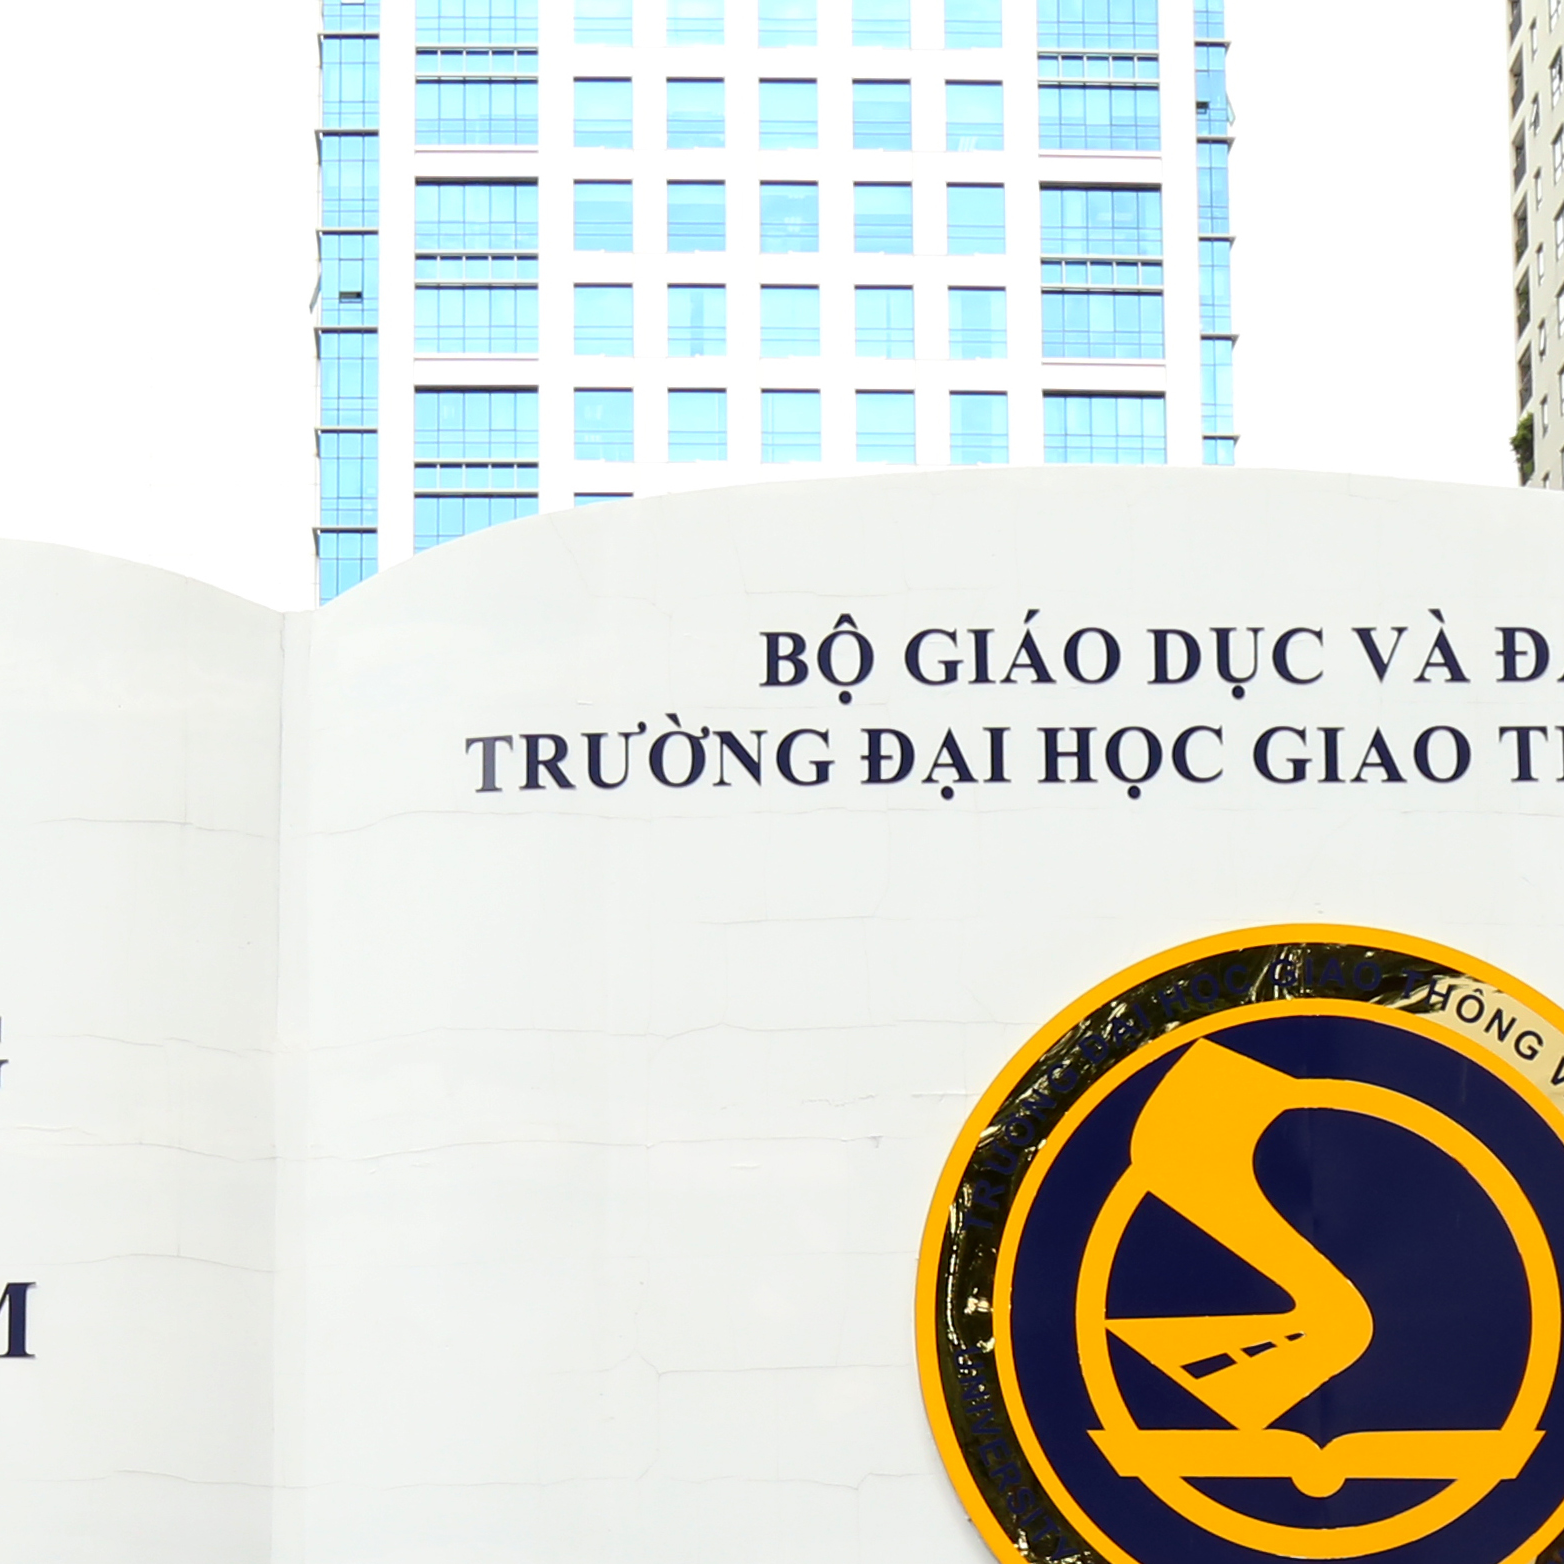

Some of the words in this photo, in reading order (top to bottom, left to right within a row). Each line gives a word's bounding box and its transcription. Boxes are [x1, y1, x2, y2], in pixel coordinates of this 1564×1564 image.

[759, 613, 875, 706] BỘ
[904, 608, 1121, 686] GIÁO
[1146, 627, 1325, 700] DỤC
[1351, 608, 1471, 683] VÀ
[465, 712, 835, 793] TRƯỜNG
[860, 726, 1011, 801] ĐẠI
[1037, 725, 1225, 800] HỌC
[1252, 725, 1472, 785] GIAO
[1270, 957, 1381, 992] GIAO
[1401, 967, 1545, 1061] THÔNG
